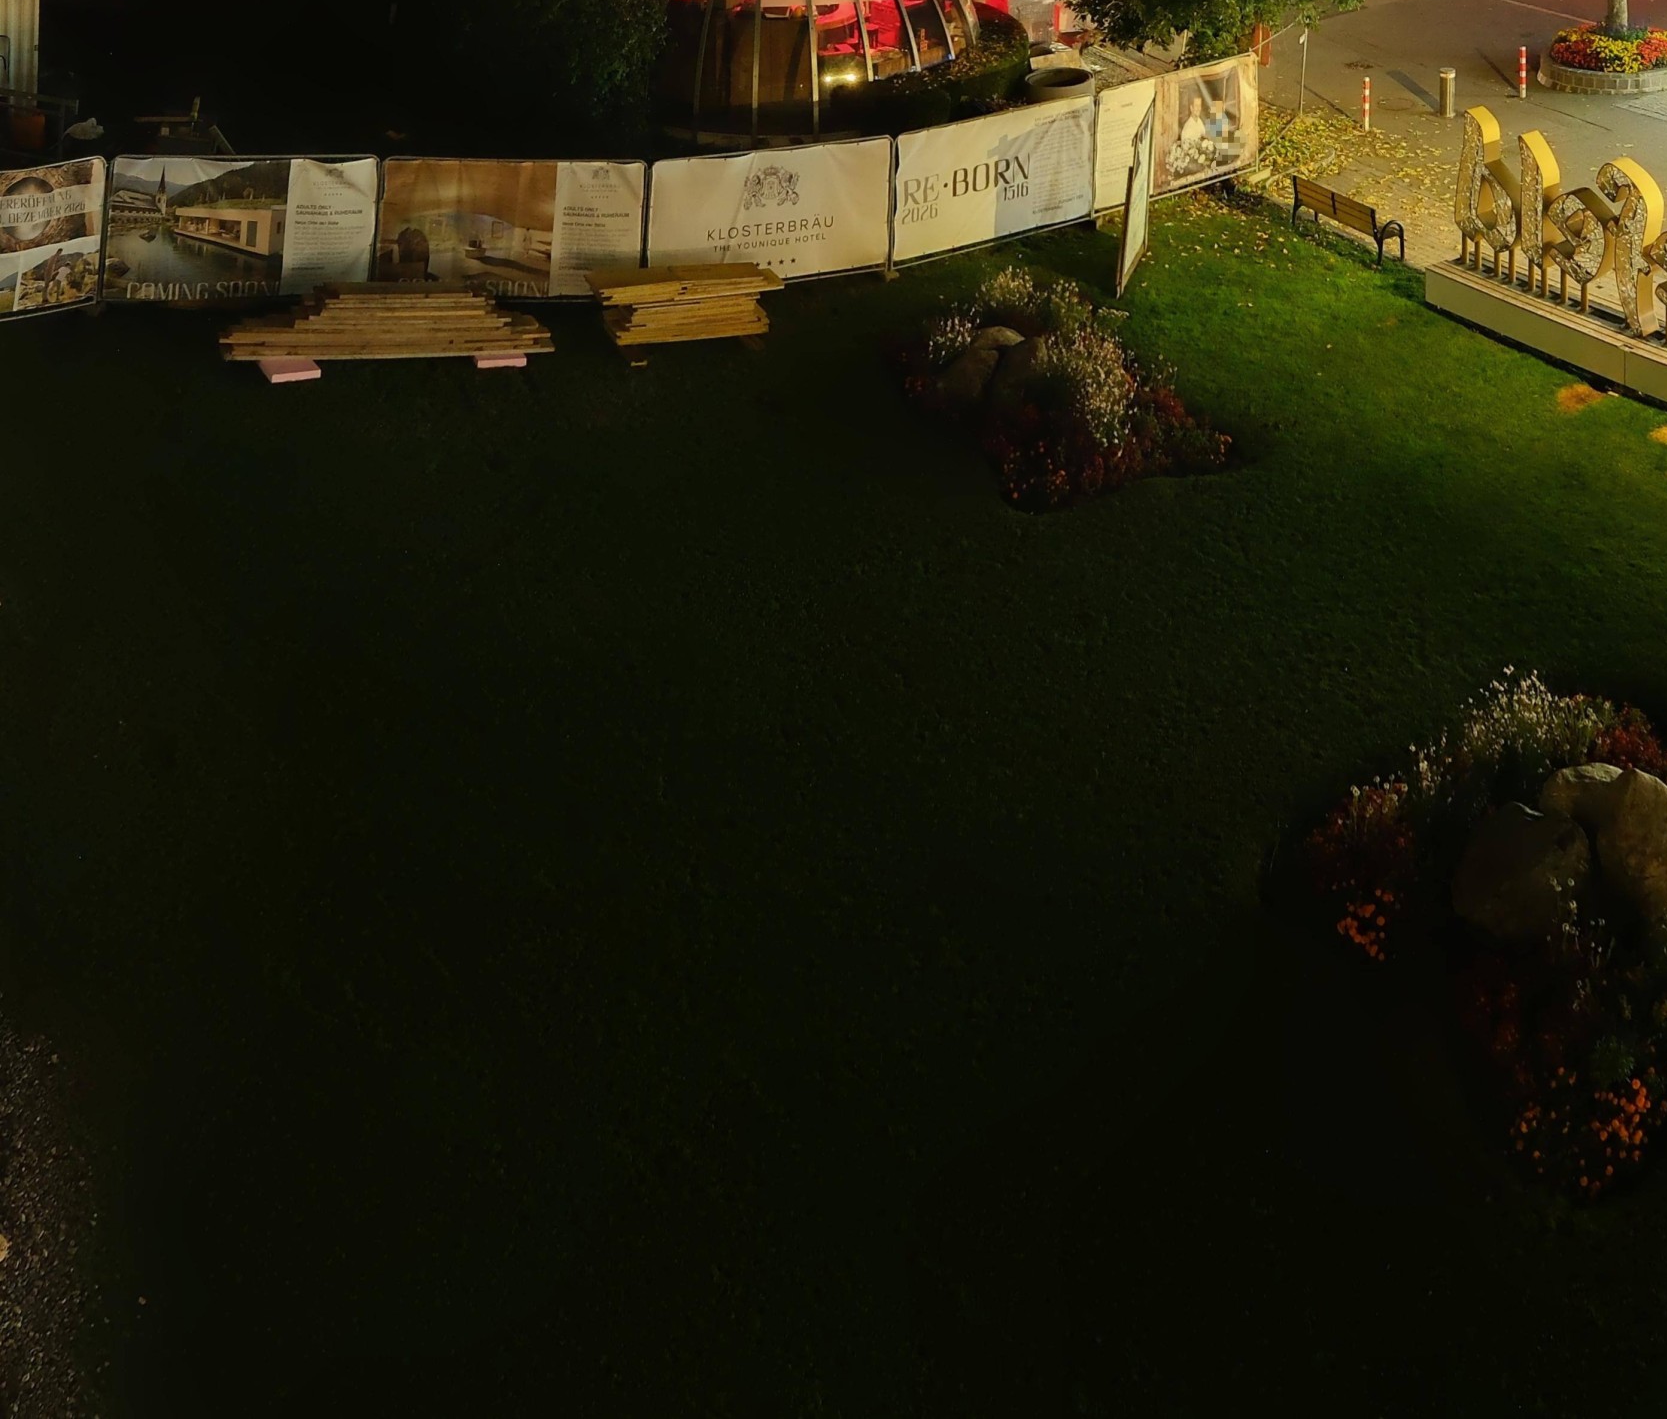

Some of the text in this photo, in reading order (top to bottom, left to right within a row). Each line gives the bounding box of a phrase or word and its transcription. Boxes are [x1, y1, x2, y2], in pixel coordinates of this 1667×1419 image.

[1003, 181, 1029, 202] 1516
[901, 203, 938, 226] 2026
[706, 213, 835, 242] KLOSTERBRÄU
[713, 232, 827, 253] THE YOUNIQUE HOTEL
[126, 281, 209, 301] COMING
